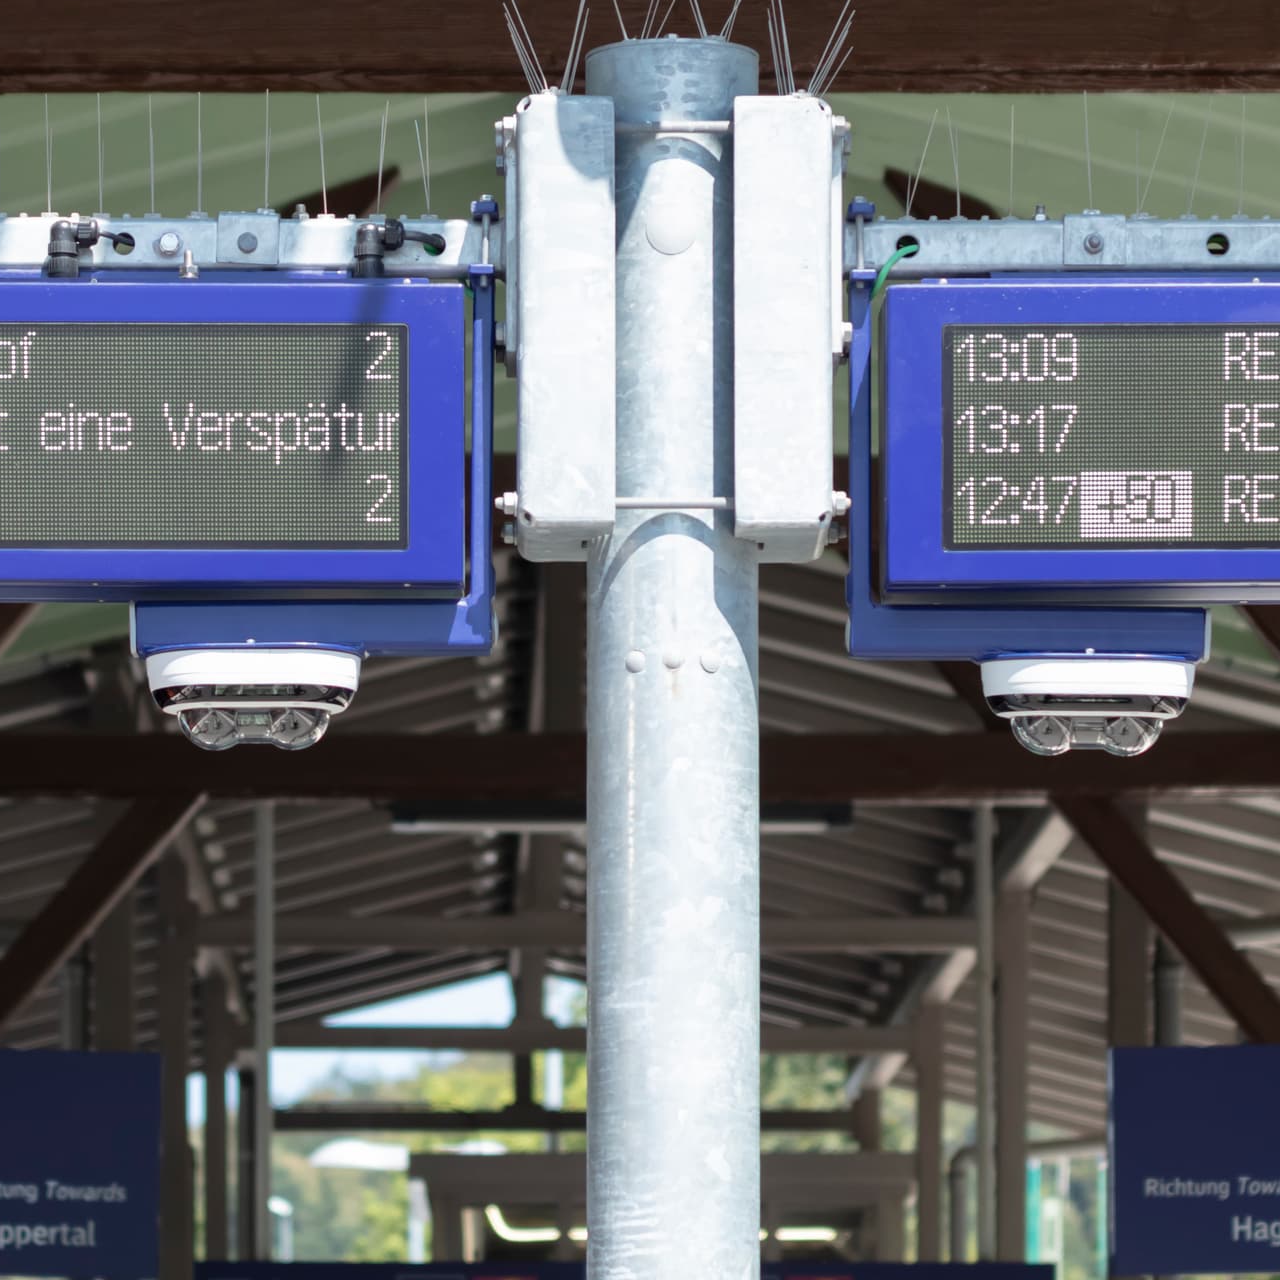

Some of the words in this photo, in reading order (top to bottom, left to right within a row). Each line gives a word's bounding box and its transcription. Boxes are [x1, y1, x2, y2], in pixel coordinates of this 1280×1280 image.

[365, 330, 392, 380] 2
[956, 333, 1078, 382] 13:09
[39, 402, 133, 452] eine
[956, 404, 1078, 453] 13:17
[365, 473, 393, 522] 2
[956, 476, 1078, 525] 12:47
[1096, 474, 1178, 524] +50
[46, 1181, 126, 1203] Towards
[1144, 1178, 1231, 1200] Richtung
